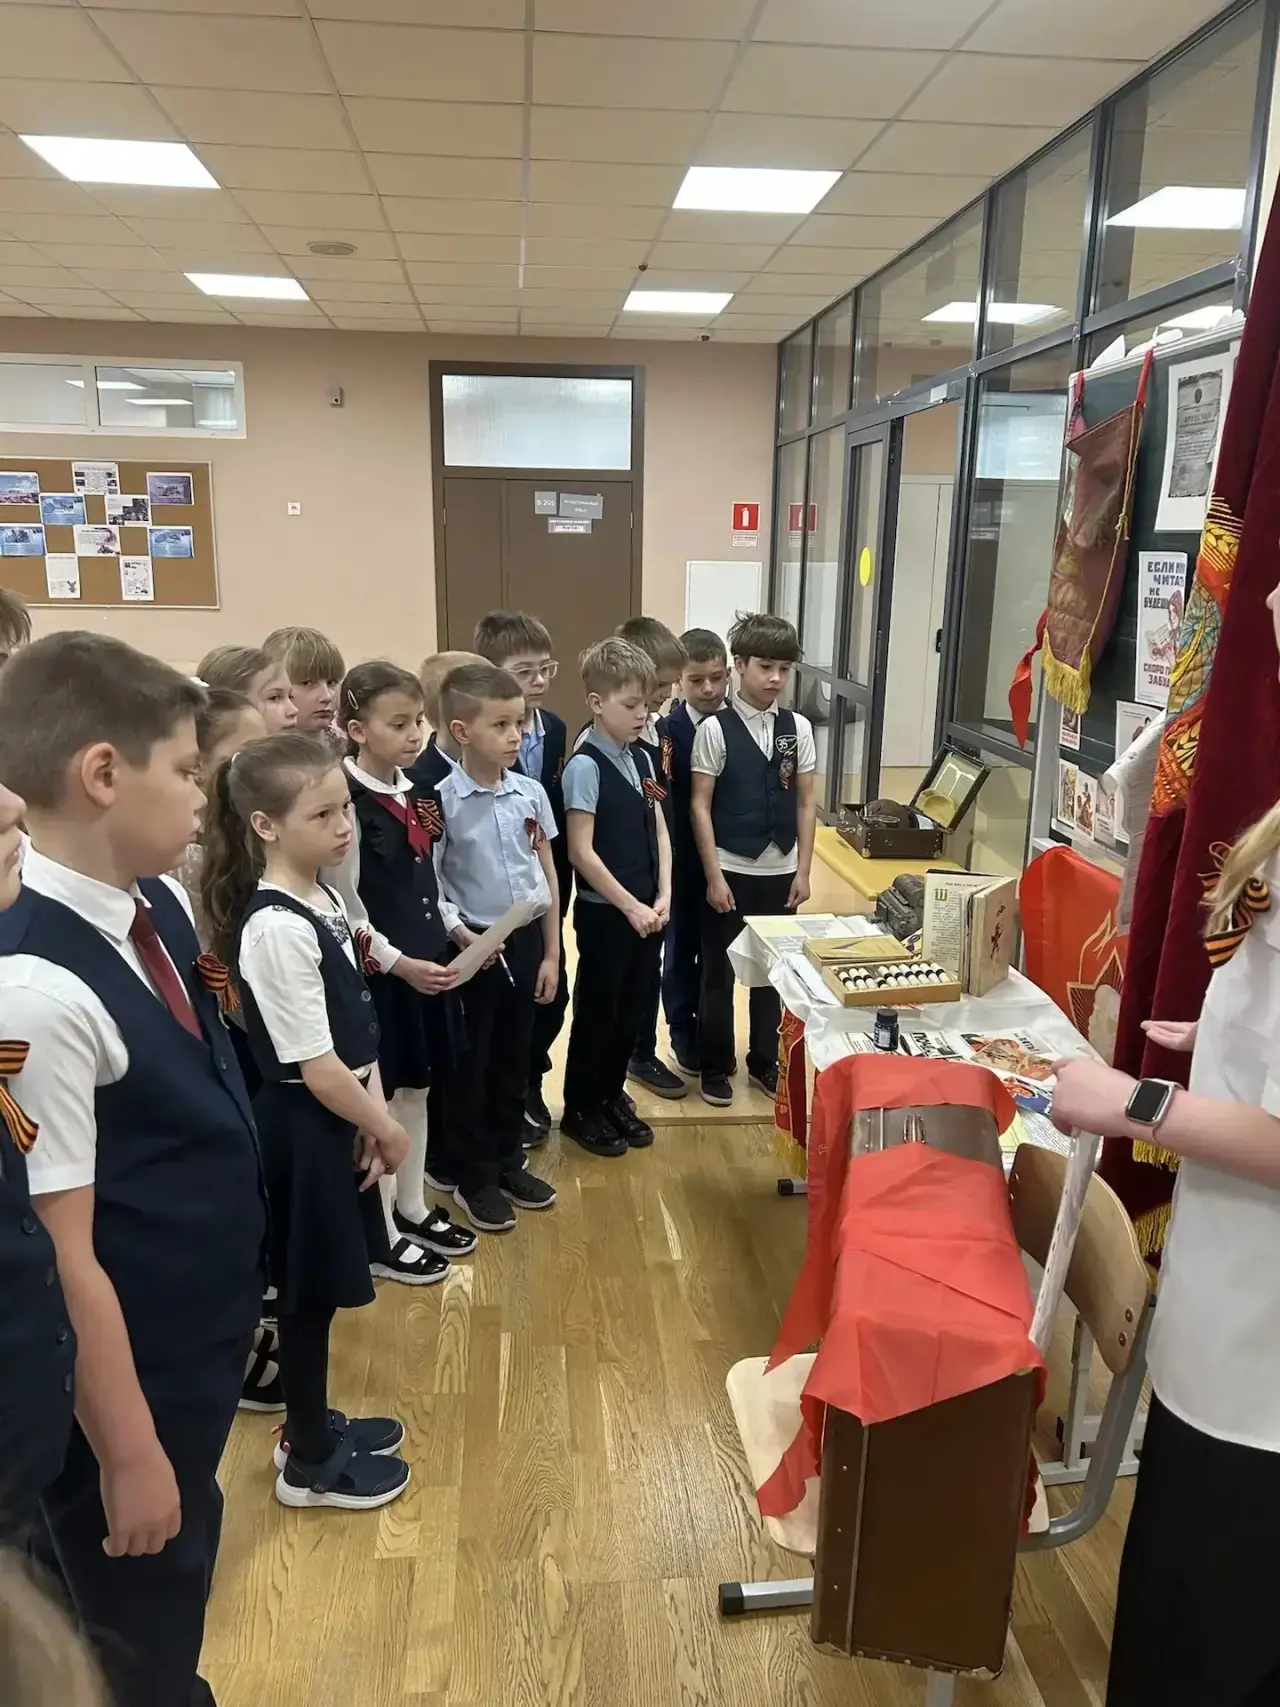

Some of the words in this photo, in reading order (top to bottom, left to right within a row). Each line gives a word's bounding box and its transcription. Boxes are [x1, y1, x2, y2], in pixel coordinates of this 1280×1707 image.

[1148, 561, 1175, 573] ЕСЛИ
[1153, 574, 1185, 587] ЧИТАТ
[1149, 587, 1161, 596] НЕ
